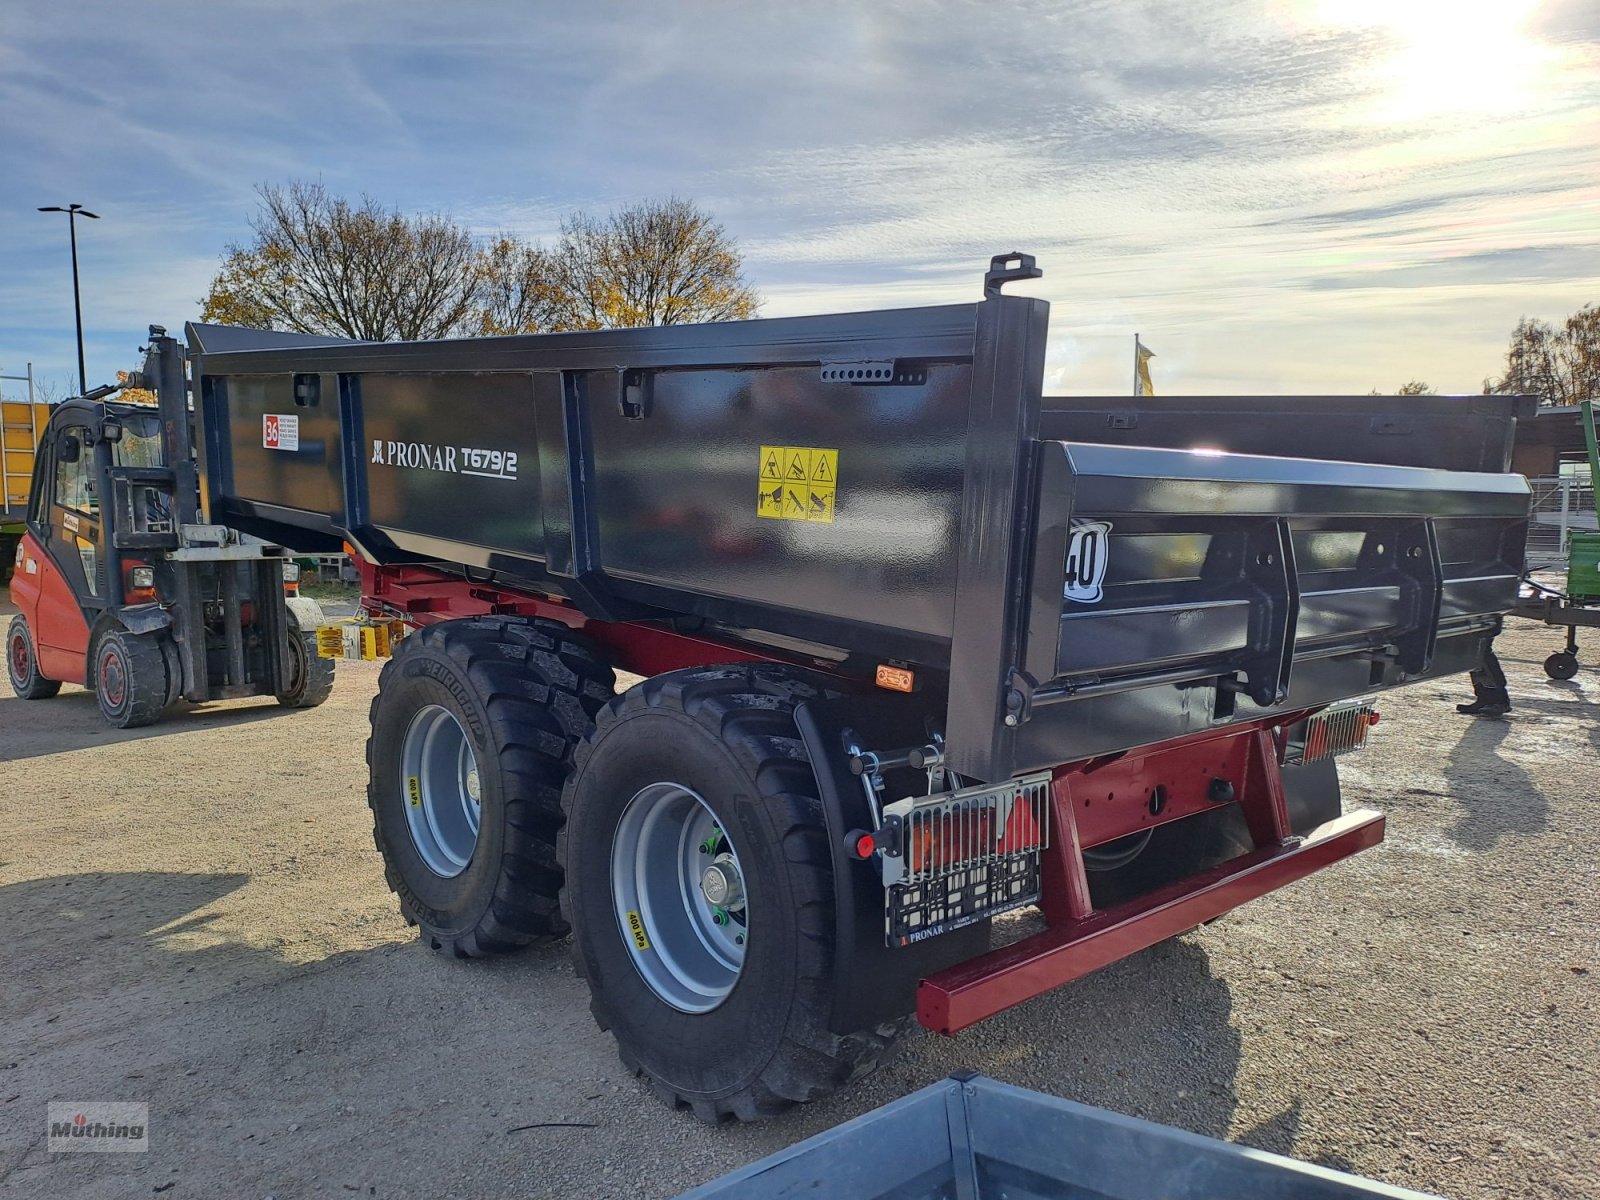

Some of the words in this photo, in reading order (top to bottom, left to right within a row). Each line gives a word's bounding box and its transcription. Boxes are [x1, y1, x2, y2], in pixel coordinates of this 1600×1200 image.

[266, 421, 278, 442] 36
[387, 441, 457, 473] PRONAR
[461, 447, 518, 476] T679/2
[1065, 530, 1099, 590] 40
[629, 914, 640, 930] 400
[634, 931, 645, 948] kPa
[909, 925, 945, 943] PRONAR
